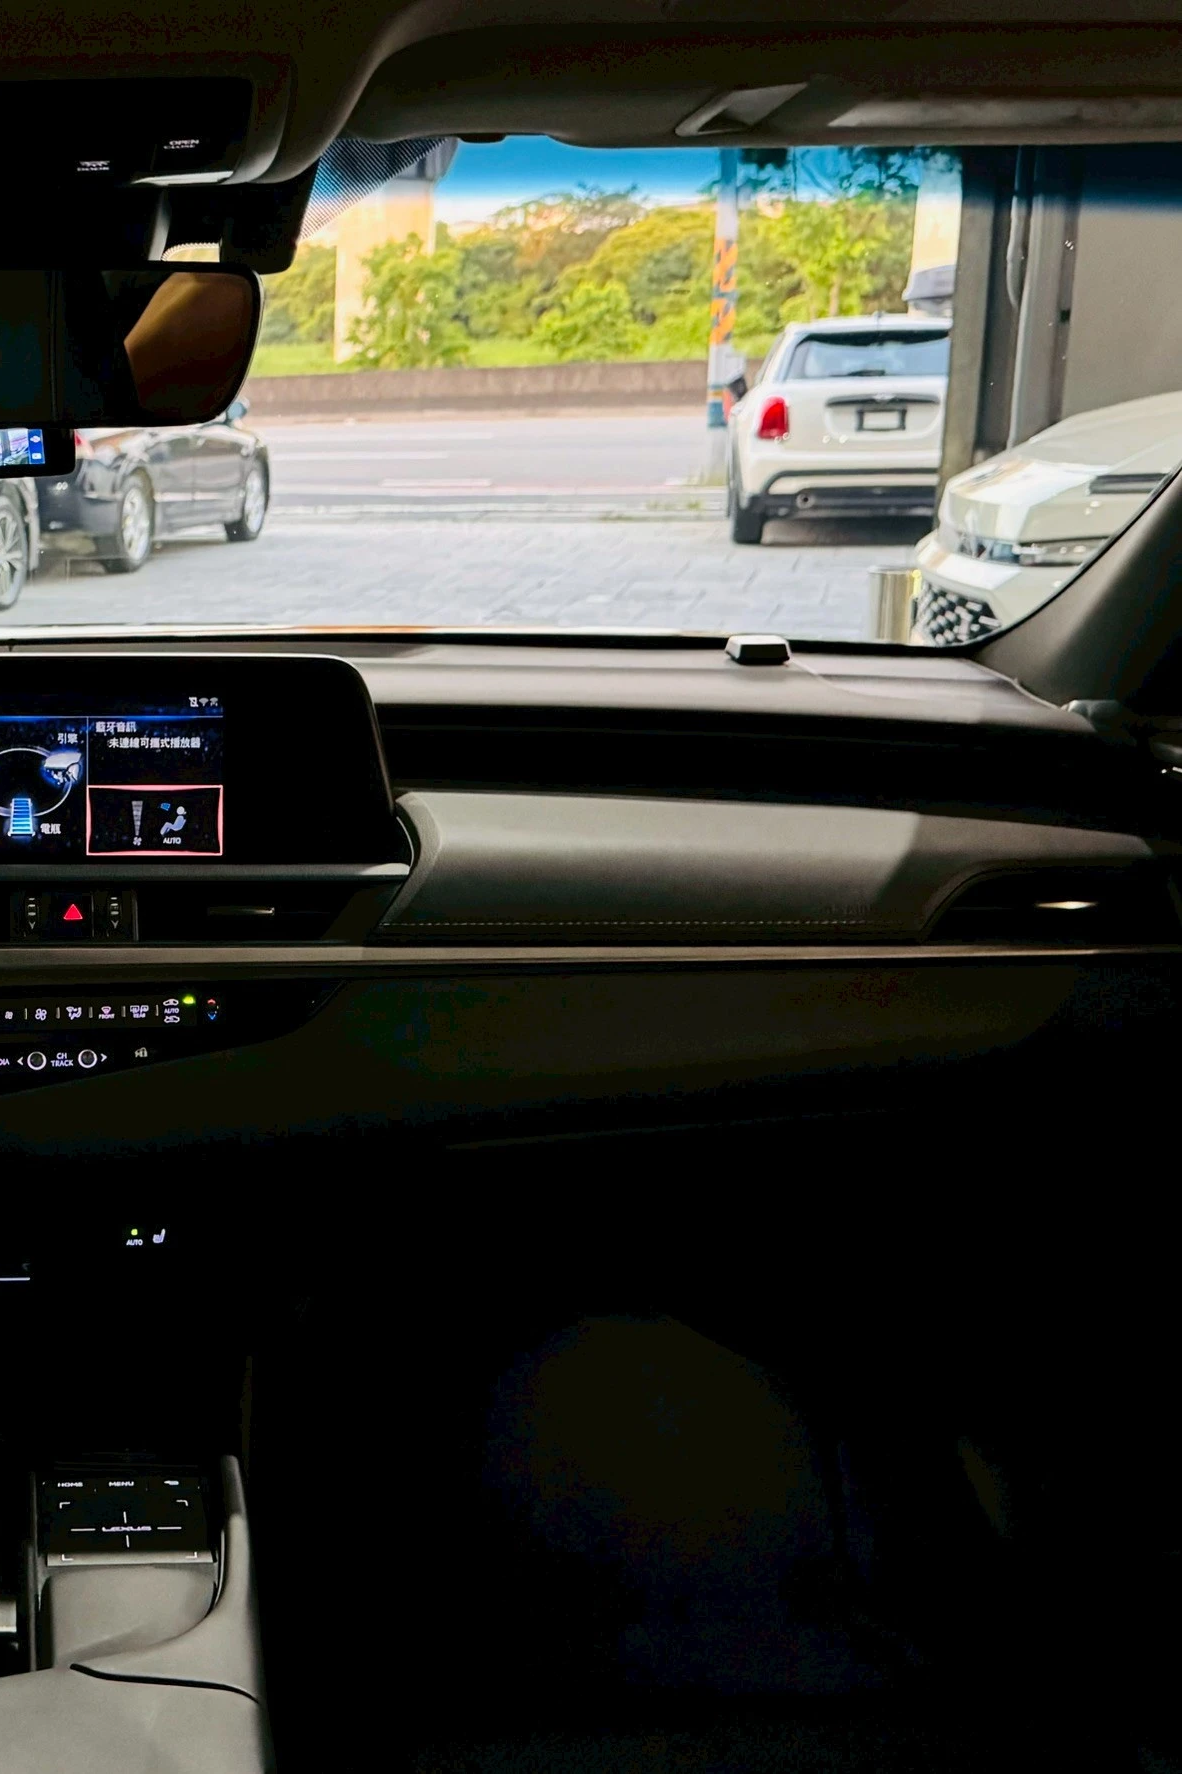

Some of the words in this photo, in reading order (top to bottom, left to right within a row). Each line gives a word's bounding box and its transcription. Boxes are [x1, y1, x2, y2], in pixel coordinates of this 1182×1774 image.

[163, 1007, 180, 1015] AUTO
[56, 1052, 68, 1060] CH
[125, 1238, 144, 1246] AUTO
[101, 1525, 152, 1533] LEXUS
